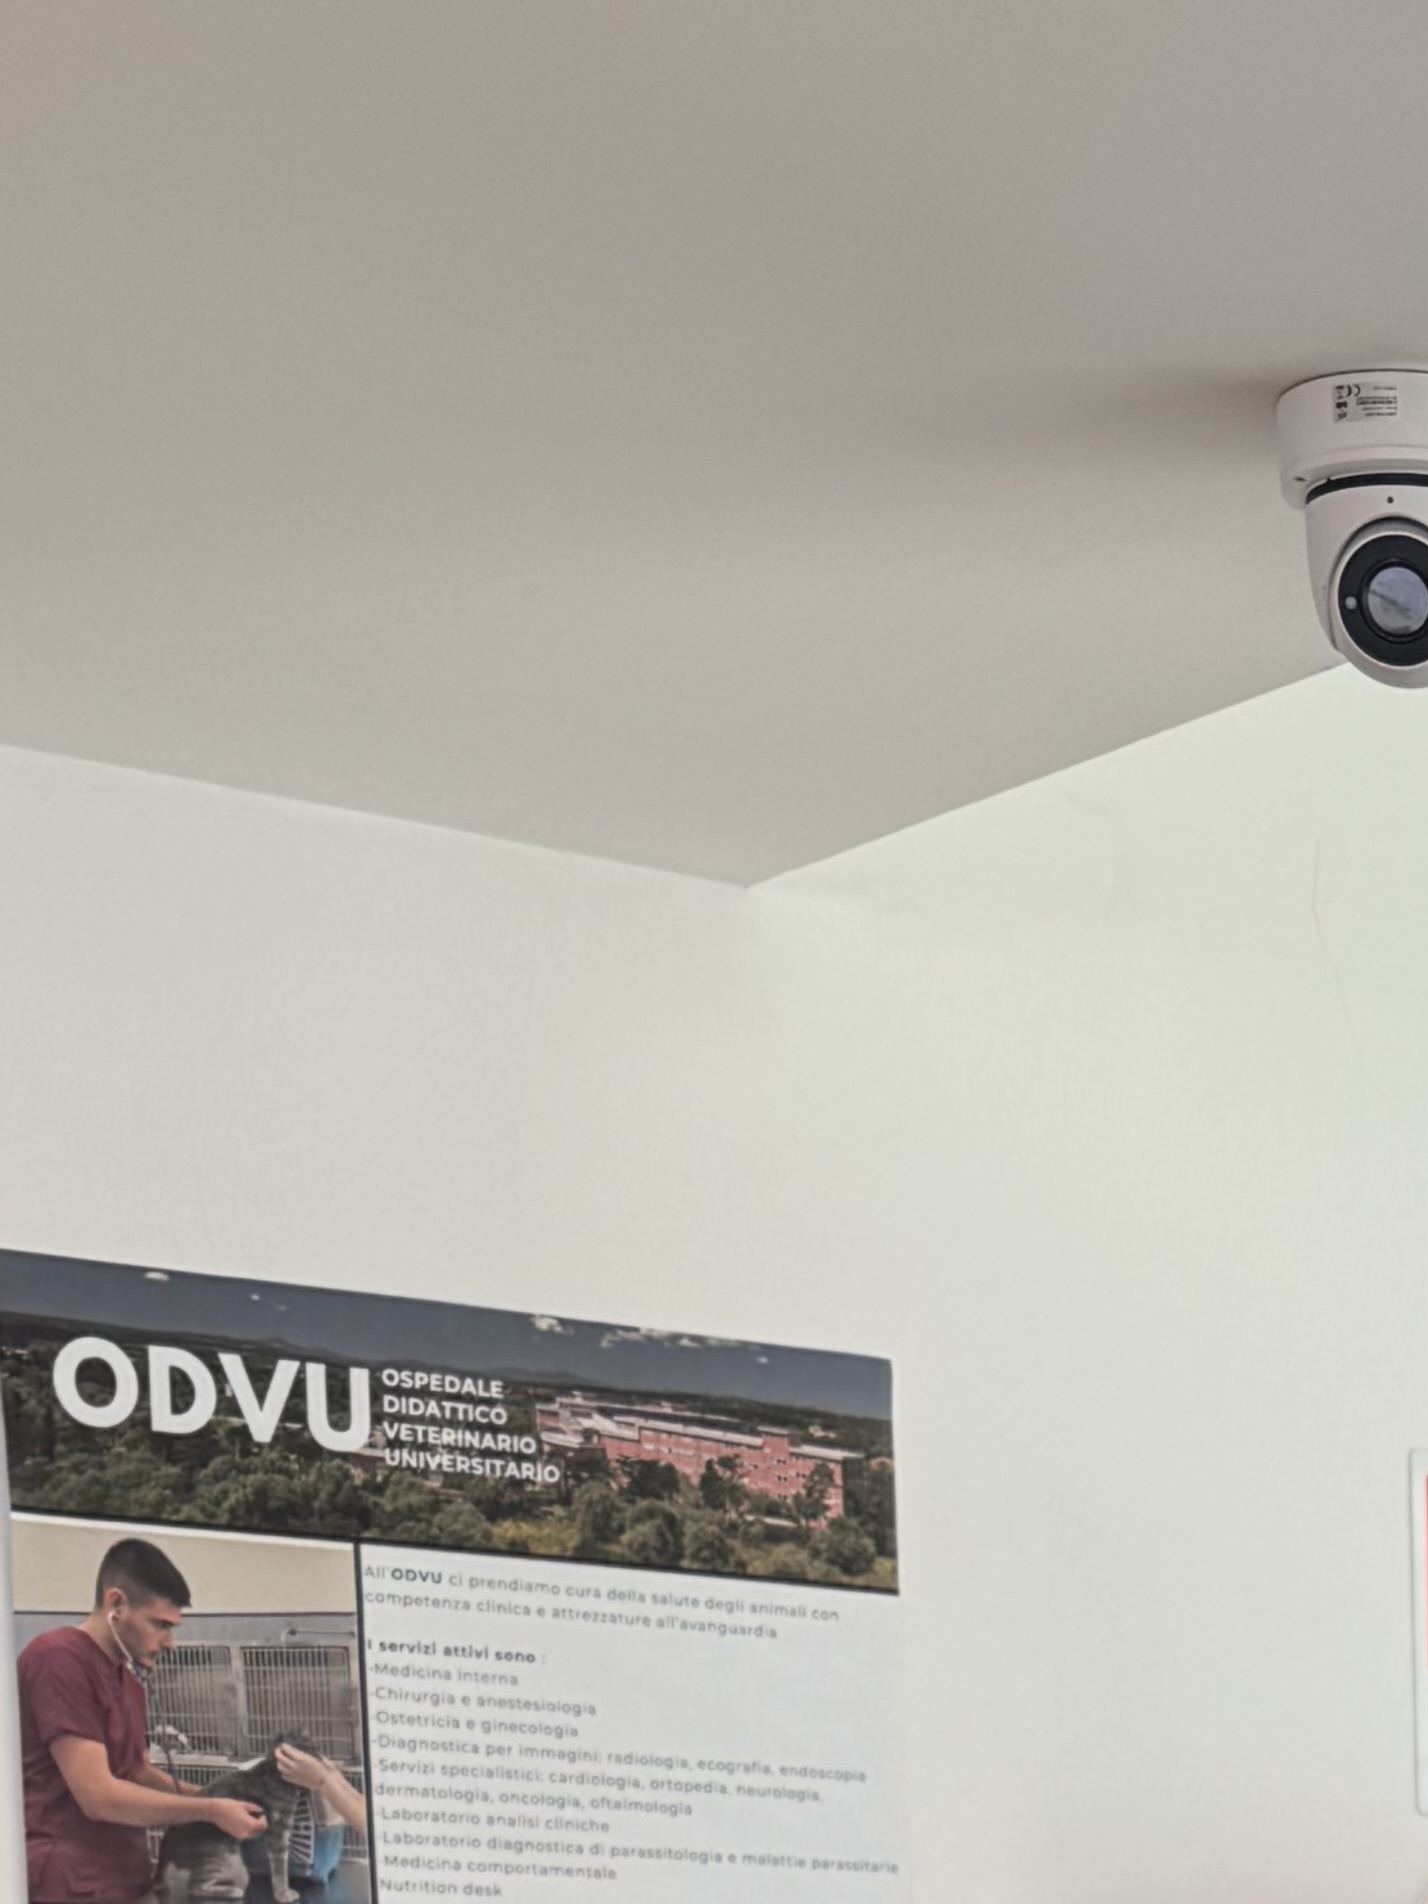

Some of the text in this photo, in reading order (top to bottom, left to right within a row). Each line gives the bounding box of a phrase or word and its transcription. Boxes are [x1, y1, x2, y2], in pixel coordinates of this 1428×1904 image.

[52, 1336, 371, 1453] ODVU
[381, 1367, 504, 1400] OSPEDALE
[382, 1395, 508, 1426] DIDATTICO
[382, 1421, 537, 1455] VETERINARIO
[384, 1447, 560, 1484] UNIVERSITARIO
[365, 1566, 839, 1621] All'ODVU ci prendiamo cura della salute degli animali con
[365, 1591, 778, 1639] competenza clinica e attrezzature all'avanguardia
[379, 1641, 437, 1656] servizi
[443, 1645, 489, 1660] attivi
[495, 1651, 537, 1664] sono
[457, 1669, 519, 1687] interna
[461, 1696, 472, 1707] e
[477, 1696, 598, 1717] anestesiologia
[466, 1719, 475, 1730] e
[481, 1720, 579, 1740] ginecologia
[485, 1742, 513, 1758] per
[779, 1764, 866, 1783] endoscopia
[590, 1795, 692, 1817] oftalmologia
[486, 1814, 540, 1829] analisi
[545, 1818, 610, 1834] cliniche
[467, 1859, 617, 1881] comportamentale
[486, 1836, 583, 1857] diagnostica
[589, 1842, 604, 1855] di
[611, 1842, 722, 1865] parassitologia
[727, 1854, 737, 1865] e
[742, 1851, 806, 1868] malattie
[812, 1854, 899, 1876] parassitarie
[463, 1881, 502, 1897] desk
